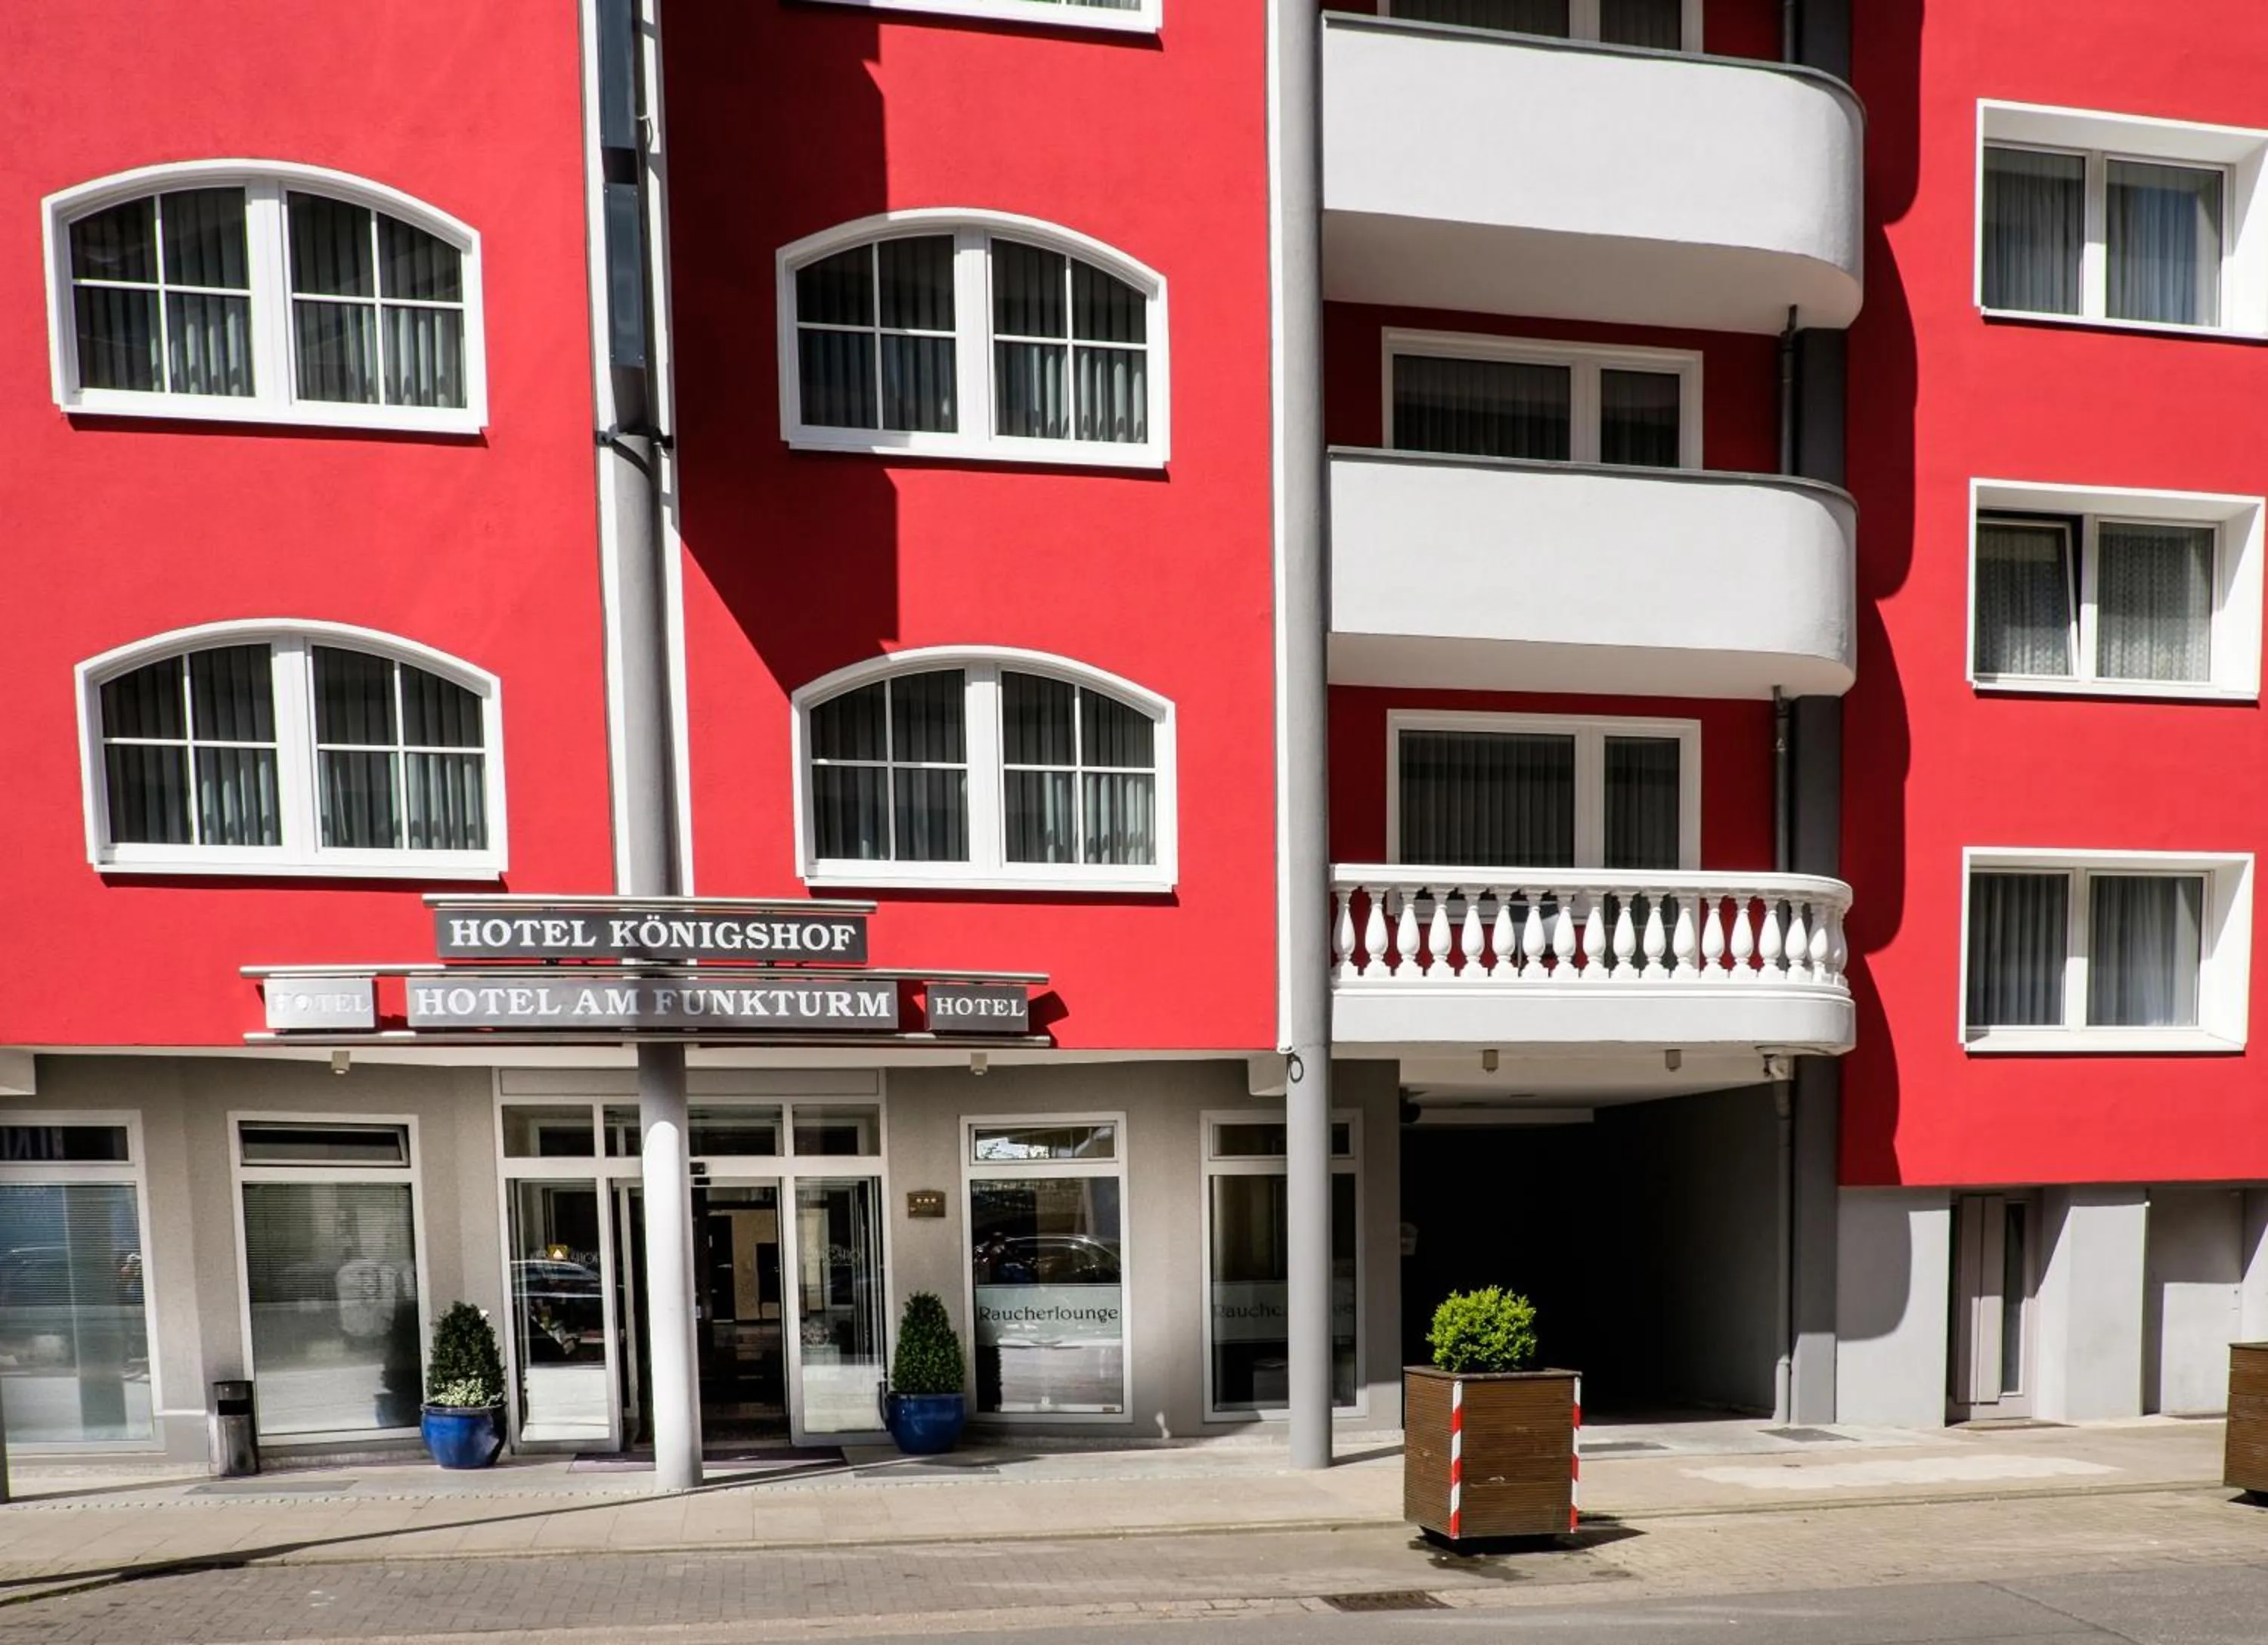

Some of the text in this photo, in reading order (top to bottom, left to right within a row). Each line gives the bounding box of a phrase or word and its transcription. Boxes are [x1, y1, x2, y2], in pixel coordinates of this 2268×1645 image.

[449, 915, 856, 951] HOTEL KÖNIGSHOF
[269, 992, 371, 1013] HOTEL
[417, 988, 890, 1017] HOTEL AM FUNKTURM
[934, 997, 1026, 1017] HOTEL
[979, 1306, 1118, 1323] Raucherlounge
